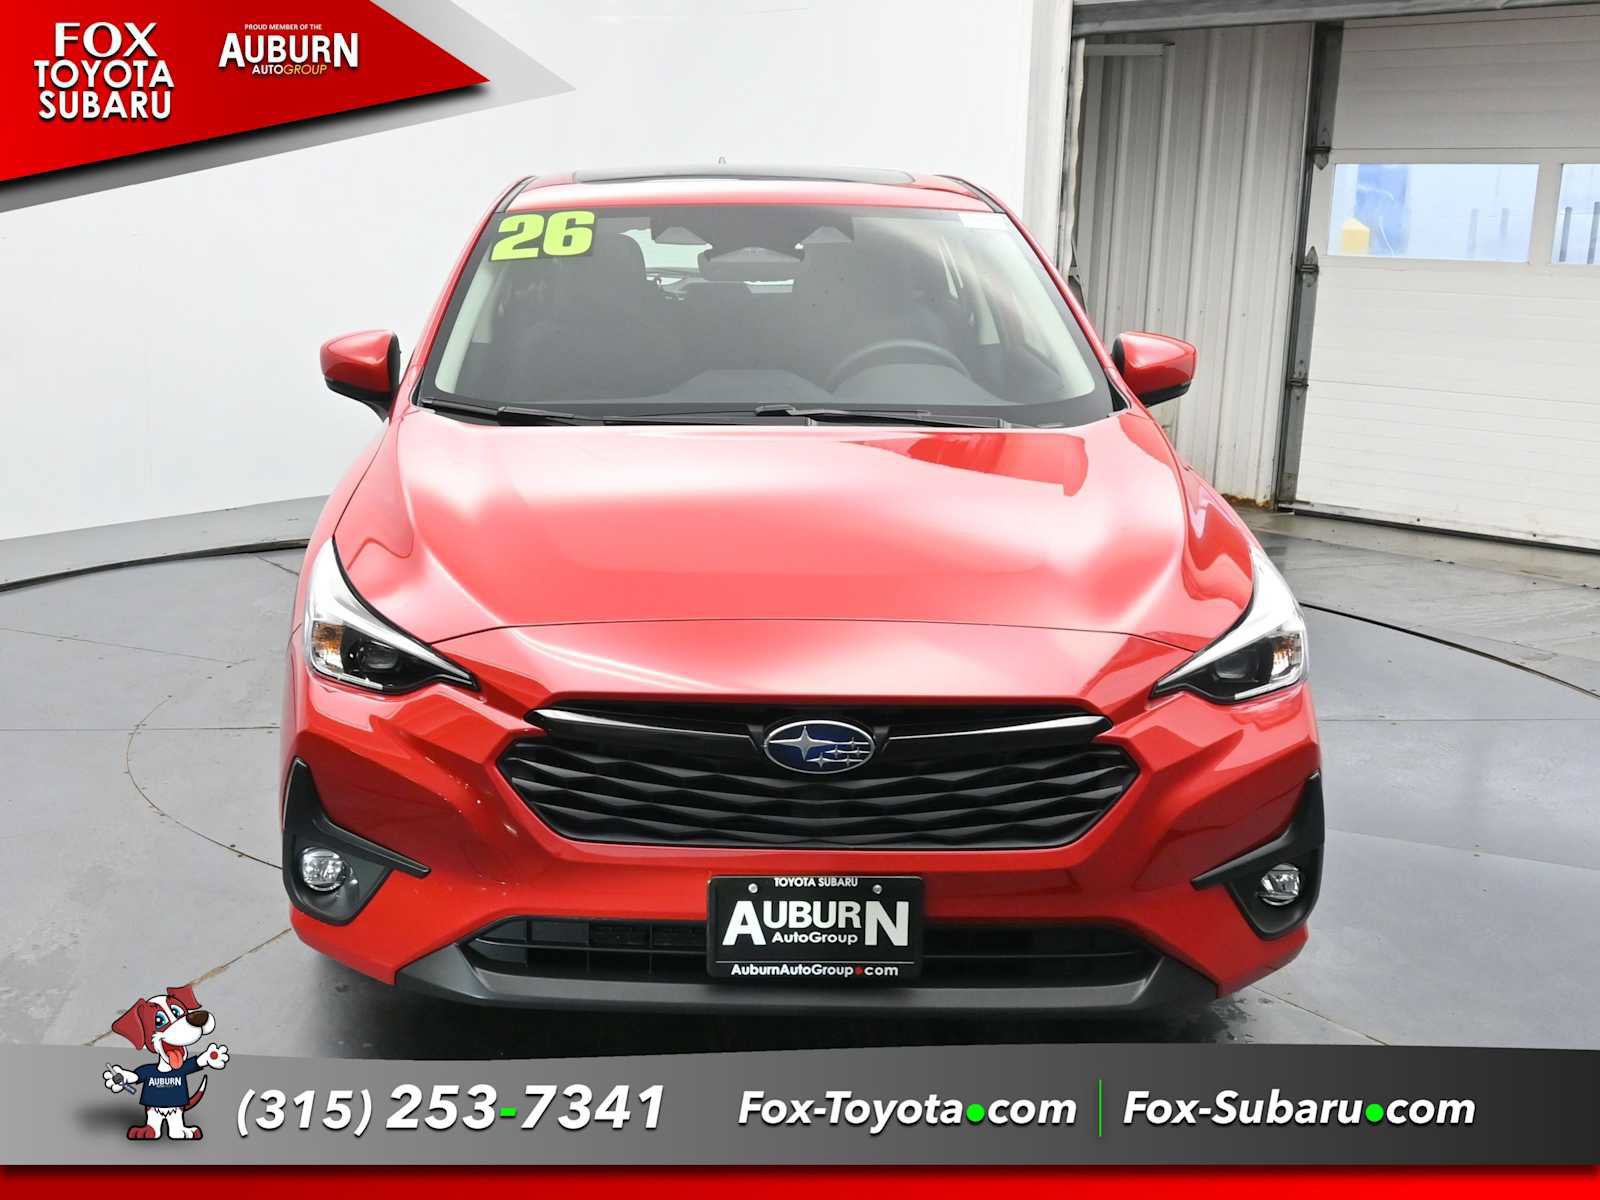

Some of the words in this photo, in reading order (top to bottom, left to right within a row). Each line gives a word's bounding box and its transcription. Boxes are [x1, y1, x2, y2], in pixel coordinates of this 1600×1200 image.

[491, 211, 595, 260] 26
[774, 877, 816, 887] TOYOTA
[818, 877, 858, 887] SUBARU
[722, 900, 909, 946] AUBURN
[771, 931, 858, 945] AutoGroup
